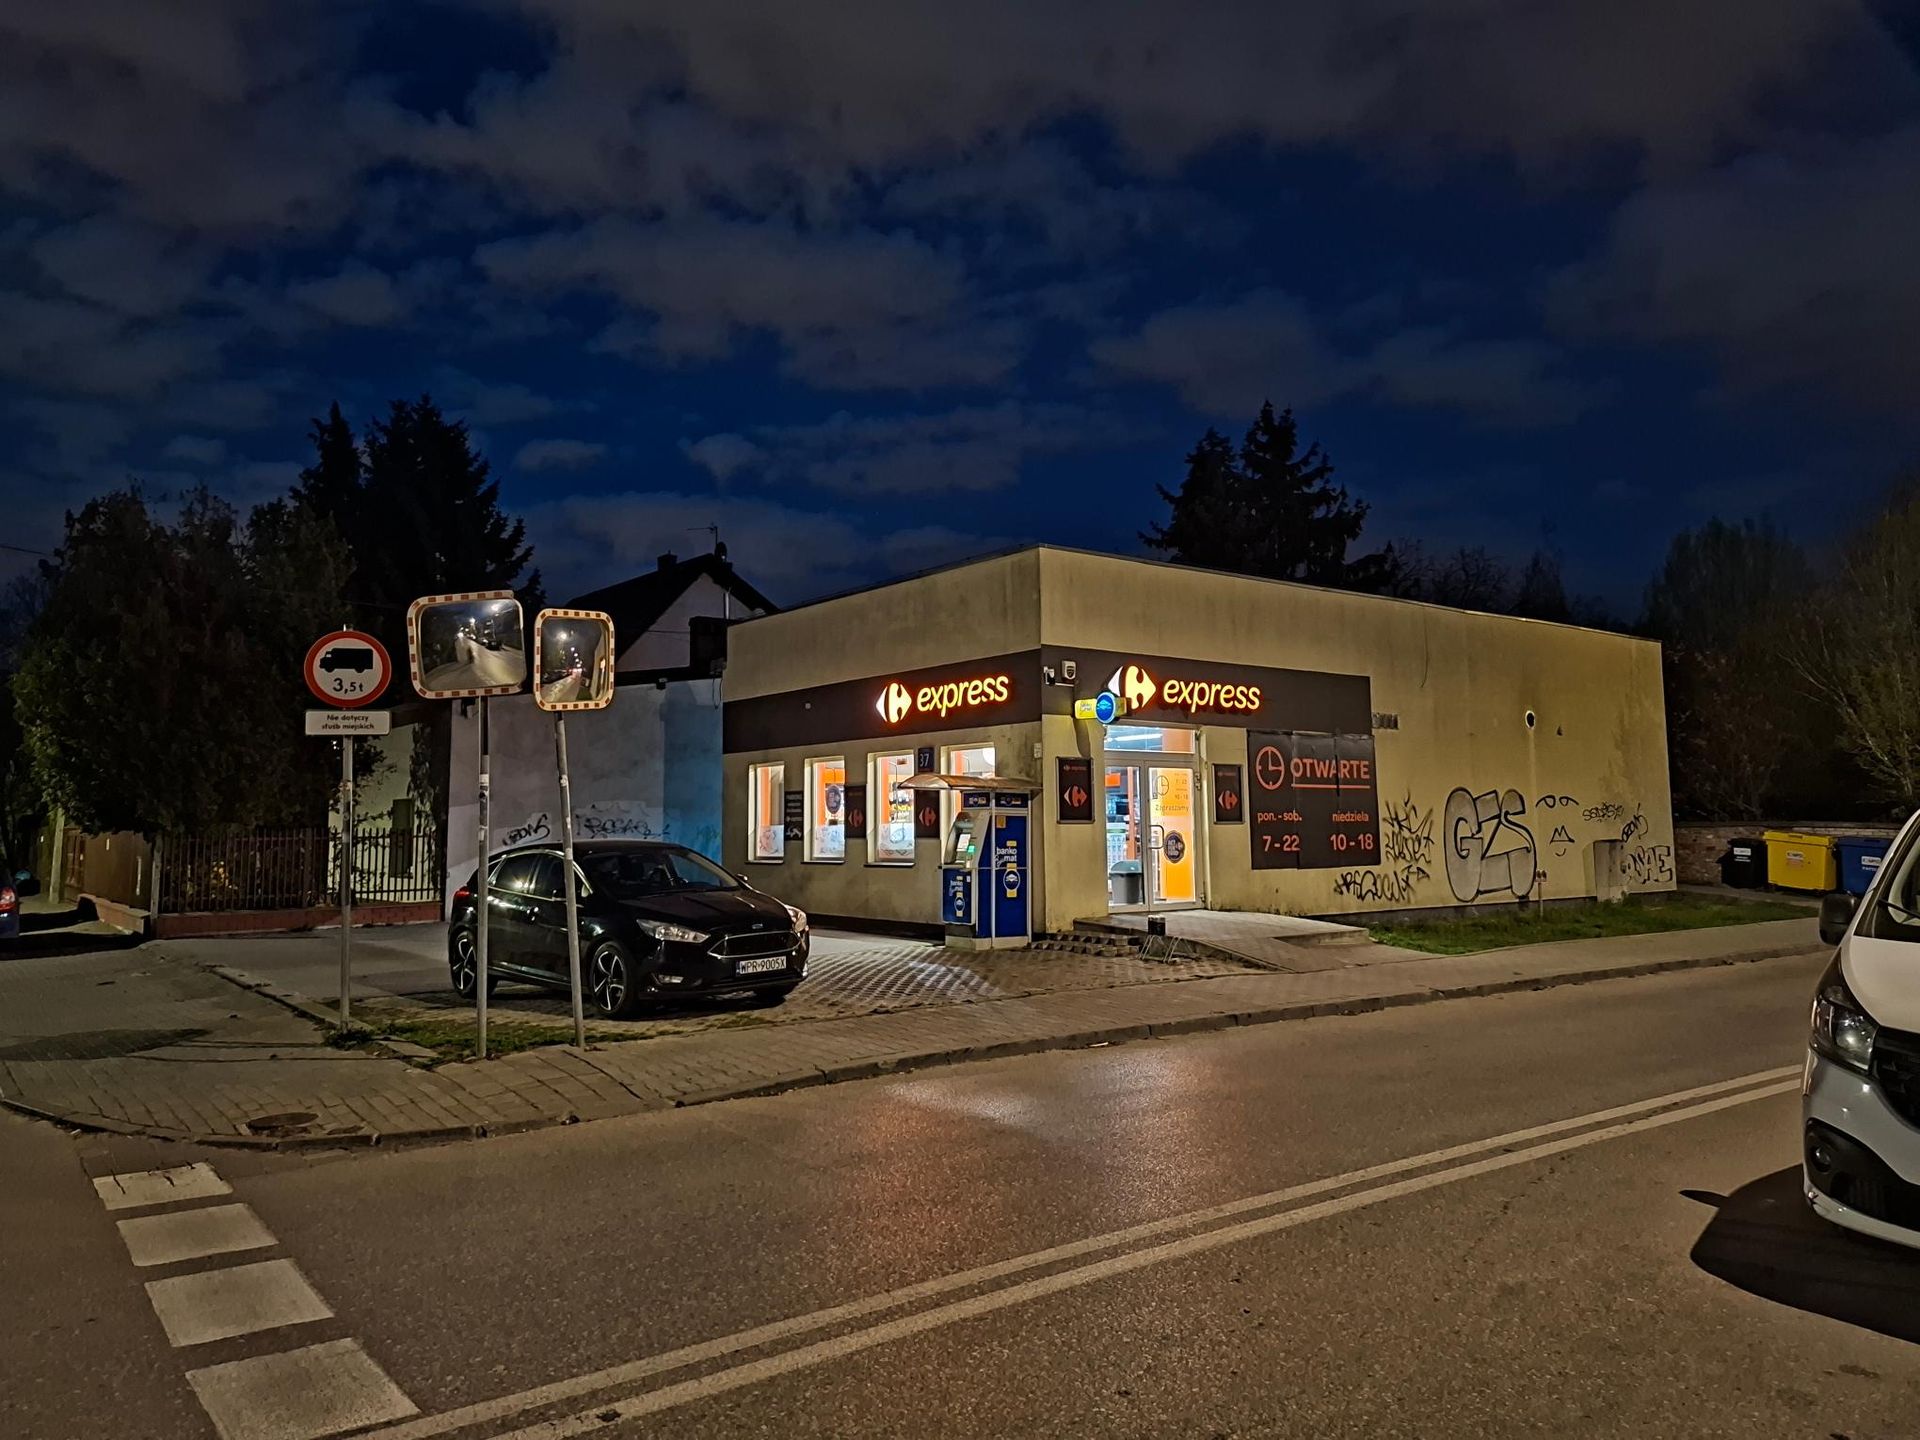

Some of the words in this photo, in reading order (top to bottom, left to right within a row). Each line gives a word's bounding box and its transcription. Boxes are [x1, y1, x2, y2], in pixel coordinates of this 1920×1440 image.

[917, 675, 1009, 718] express
[1163, 679, 1261, 713] express
[341, 714, 369, 722] dotyczy
[343, 722, 374, 731] miejskich
[1290, 757, 1370, 780] OTWARTE
[1332, 810, 1369, 822] niedziela
